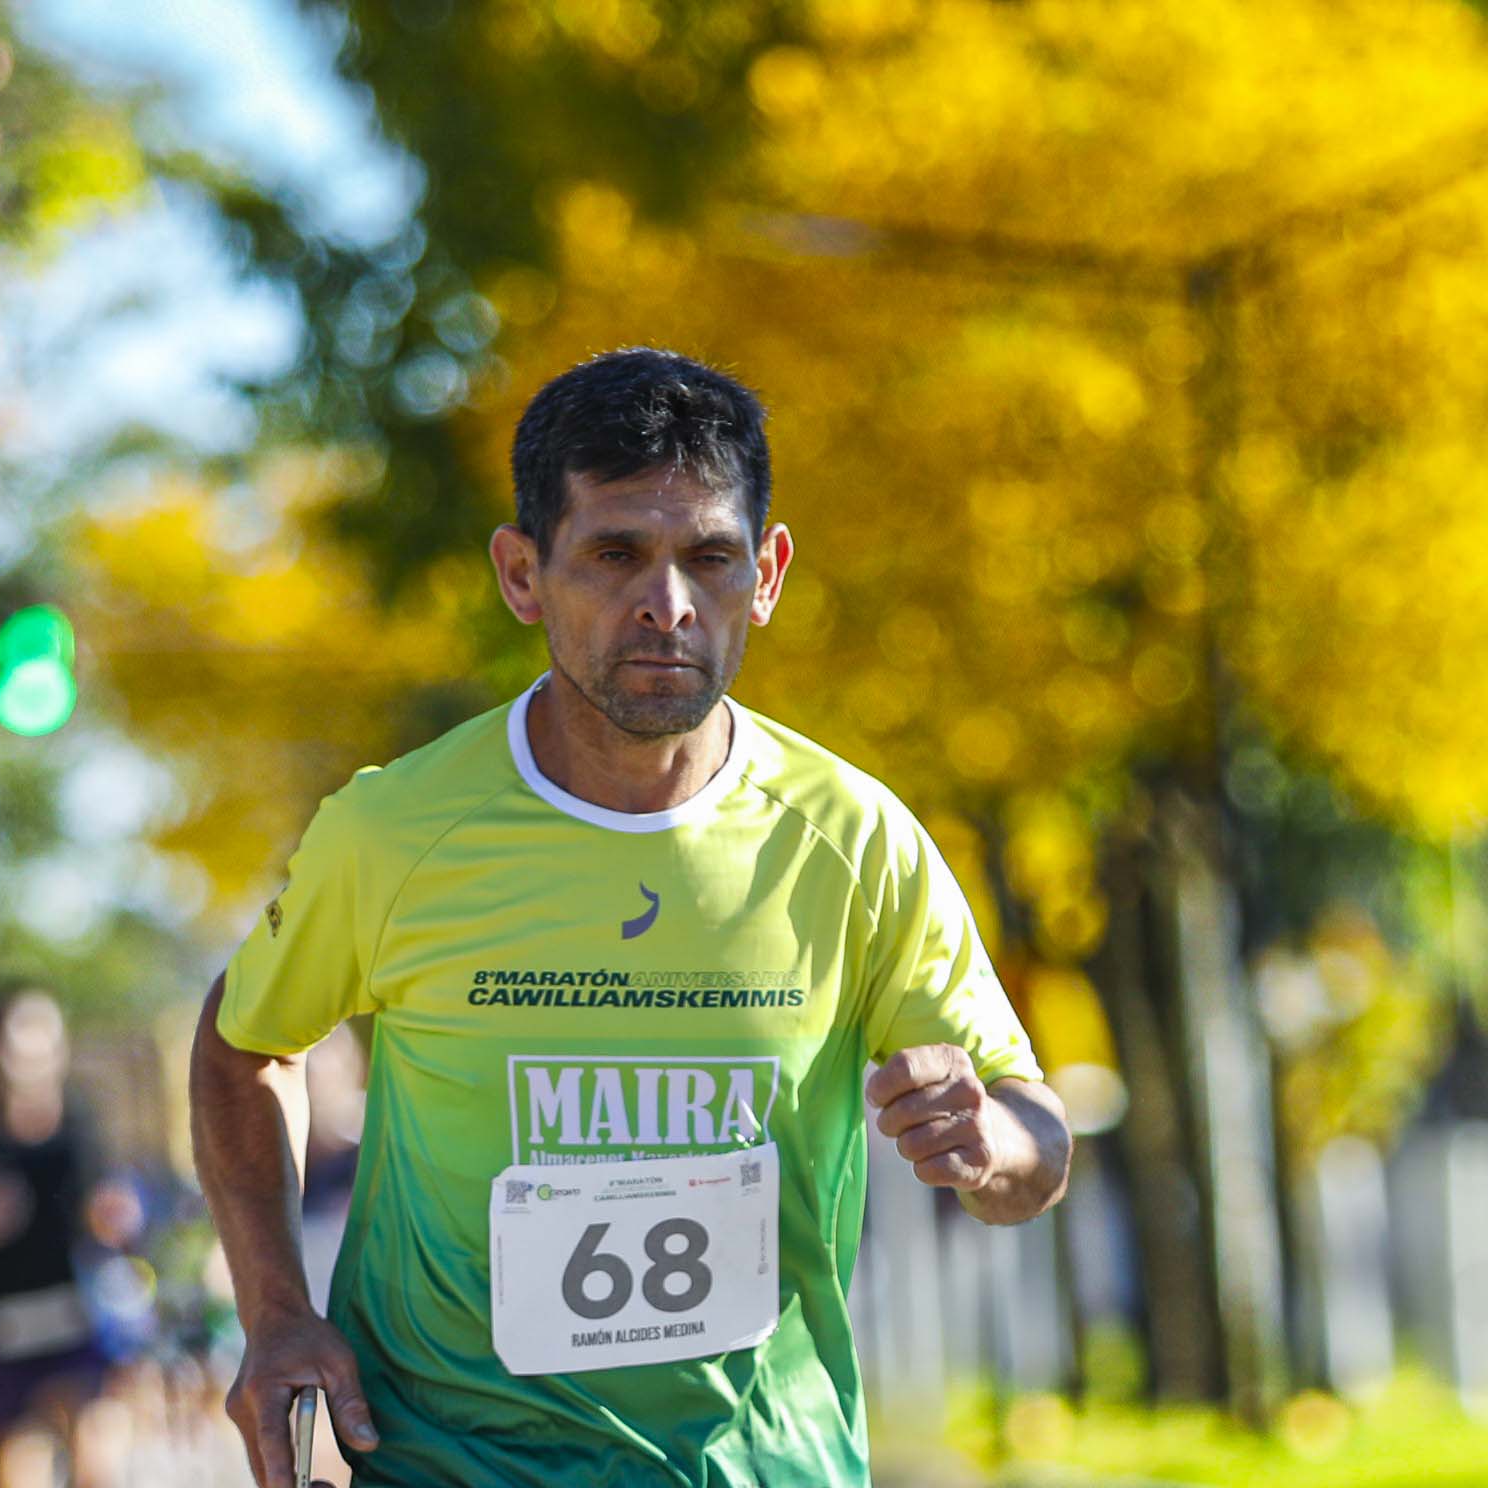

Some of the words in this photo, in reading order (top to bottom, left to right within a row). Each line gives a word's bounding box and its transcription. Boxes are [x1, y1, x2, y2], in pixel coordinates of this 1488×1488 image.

[467, 987, 805, 1008] CAWILLIAMSKEMMIS
[524, 1067, 758, 1145] MAIRA
[561, 1217, 713, 1320] 68
[571, 1328, 612, 1347] RAMÓN
[615, 1326, 661, 1344] ALCIDES
[664, 1320, 706, 1339] MEDINA
